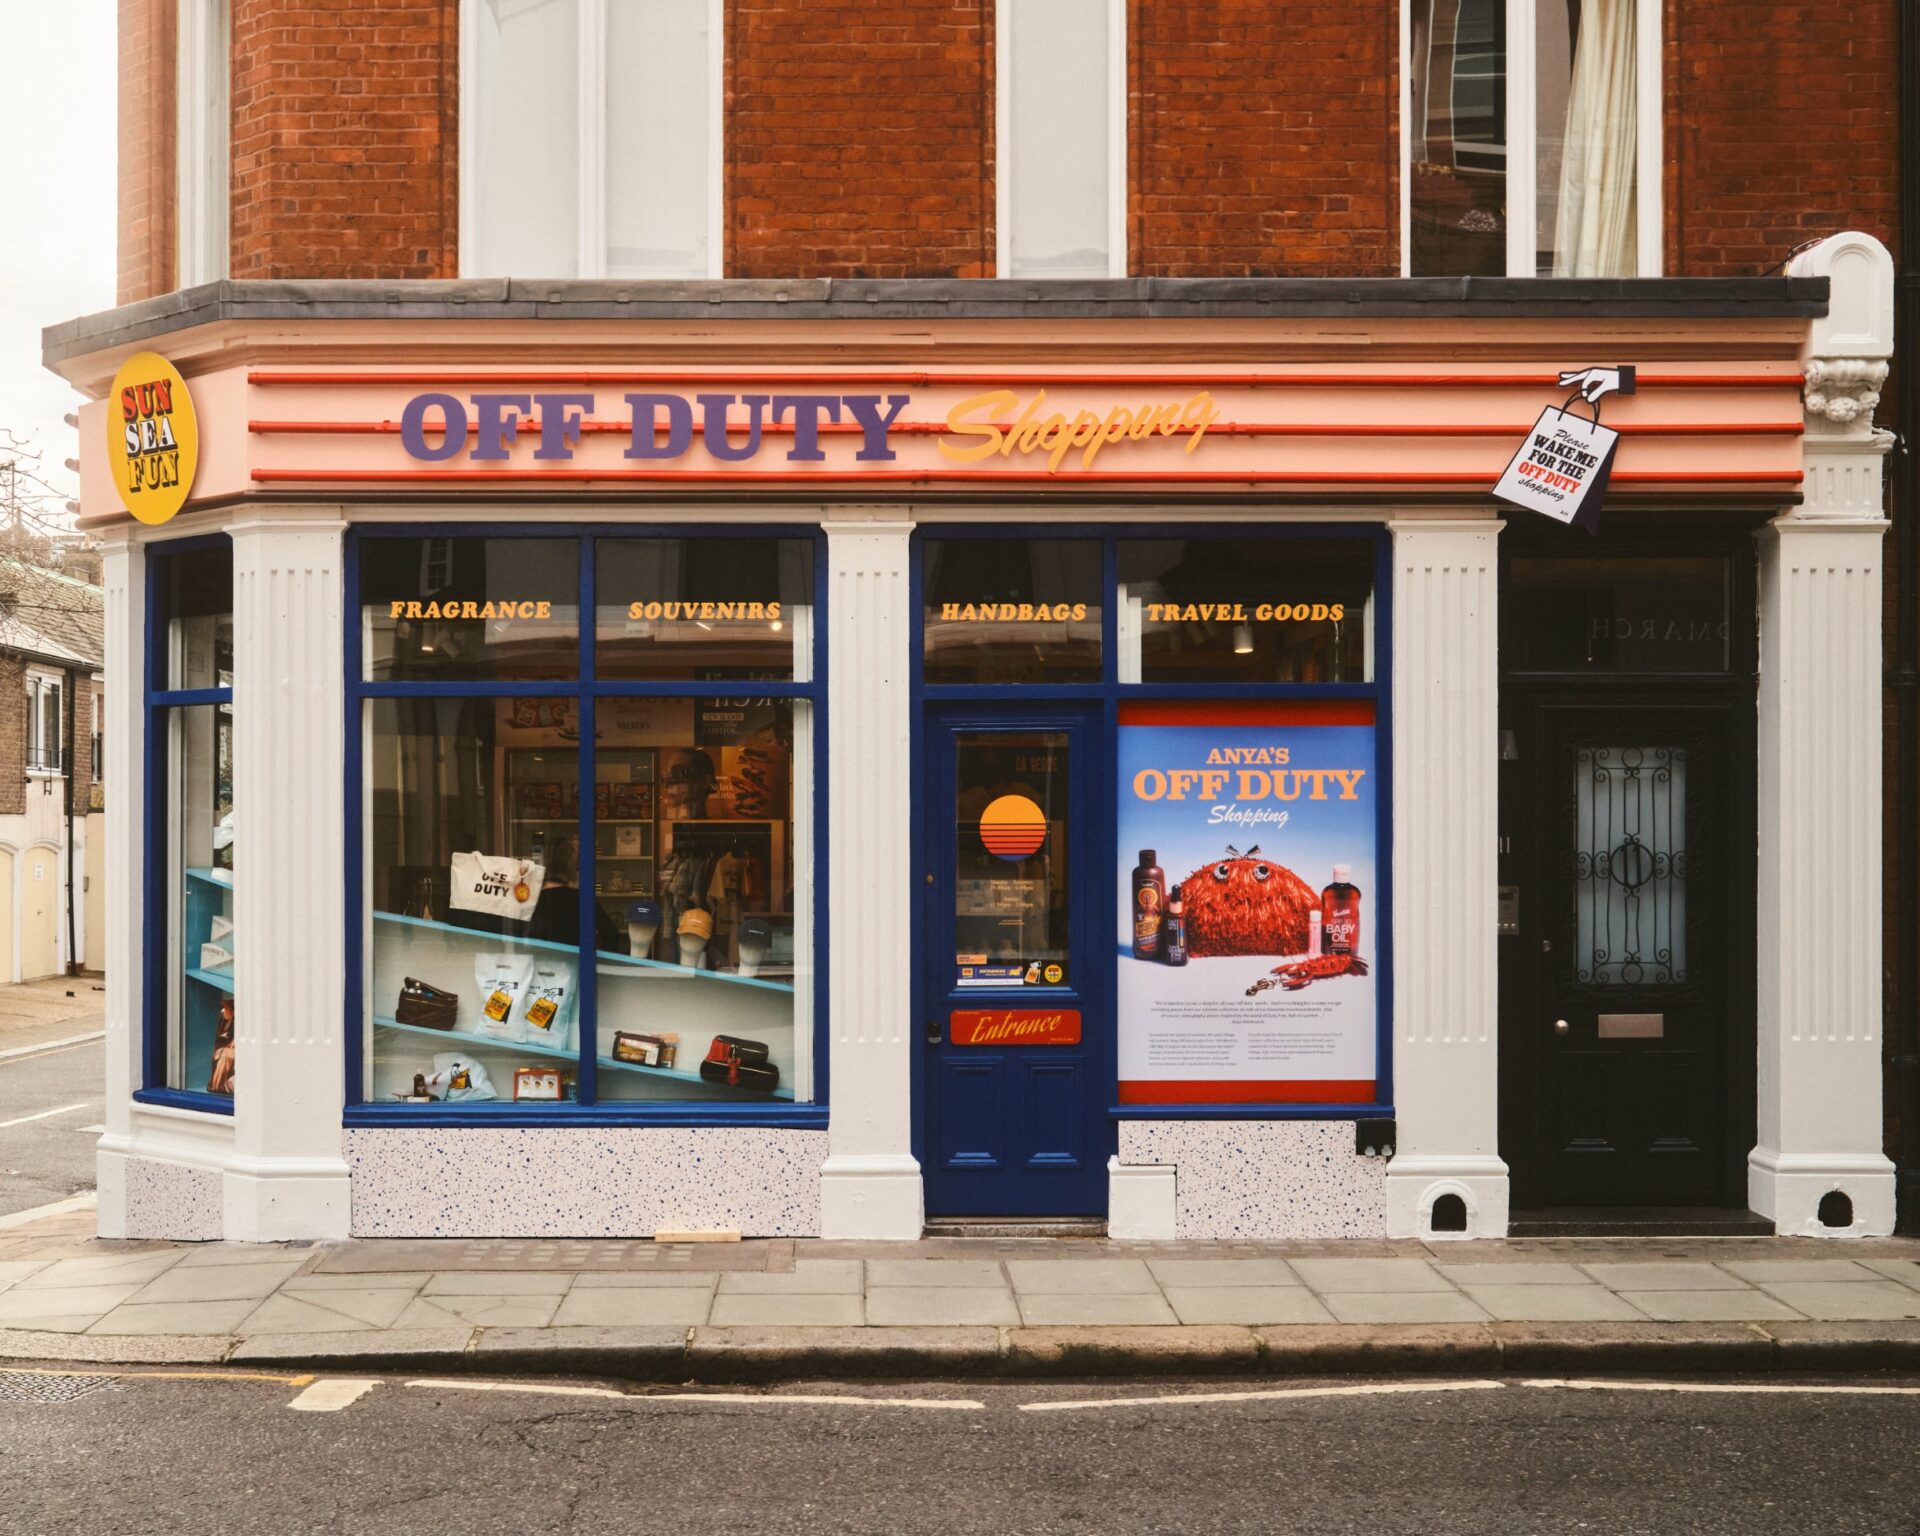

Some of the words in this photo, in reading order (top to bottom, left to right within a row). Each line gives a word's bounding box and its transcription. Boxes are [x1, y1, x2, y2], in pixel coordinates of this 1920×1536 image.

[121, 379, 173, 422] SUN
[125, 416, 178, 458] SEA
[400, 393, 595, 461] OFF
[623, 393, 911, 461] DUTY
[938, 388, 1220, 474] Shopping
[1553, 428, 1590, 450] Please
[1527, 448, 1558, 469] FOR
[1558, 458, 1586, 480] THE
[1535, 435, 1574, 459] WAKE
[1574, 450, 1599, 469] ME
[128, 451, 179, 493] FUN
[1518, 461, 1544, 480] OFF
[1544, 469, 1582, 494] DUTY
[1518, 478, 1566, 501] shopping
[389, 600, 551, 620] FRAGRANCE
[628, 601, 781, 620] SOUVENIRS
[940, 603, 1088, 621] HANDBAGS
[1147, 603, 1247, 621] TRAVEL
[1255, 603, 1345, 621] GOODS
[1206, 747, 1290, 765] ANYA'S
[1133, 769, 1230, 801] OFF
[1235, 769, 1366, 801] DUTY
[1207, 803, 1290, 828] Shopping
[474, 883, 511, 898] DUTY
[1327, 925, 1355, 934] BABY
[1332, 934, 1349, 942] OIL
[970, 1011, 1062, 1043] Entrance
